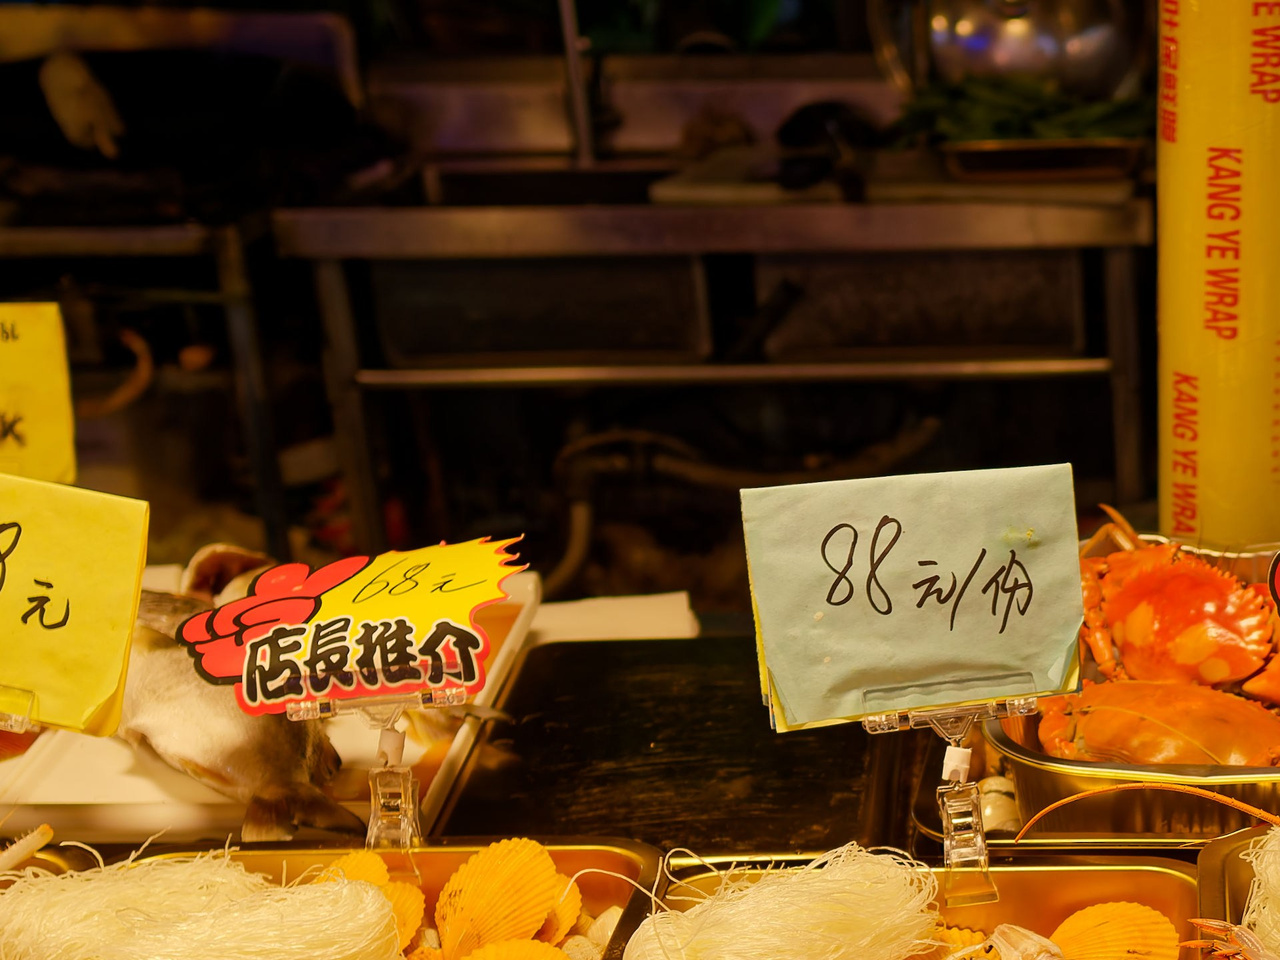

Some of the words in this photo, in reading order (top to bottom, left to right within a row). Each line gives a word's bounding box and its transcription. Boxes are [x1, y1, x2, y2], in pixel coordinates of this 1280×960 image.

[1206, 146, 1242, 221] KANG
[1206, 230, 1241, 260] YE
[1204, 268, 1240, 340] WRAP
[1172, 371, 1199, 443] KANG
[1172, 450, 1198, 478] YE
[1172, 482, 1197, 535] WRA
[352, 557, 488, 604] 68元
[821, 515, 1033, 634] 88元/份
[245, 616, 481, 703] 店長推介
